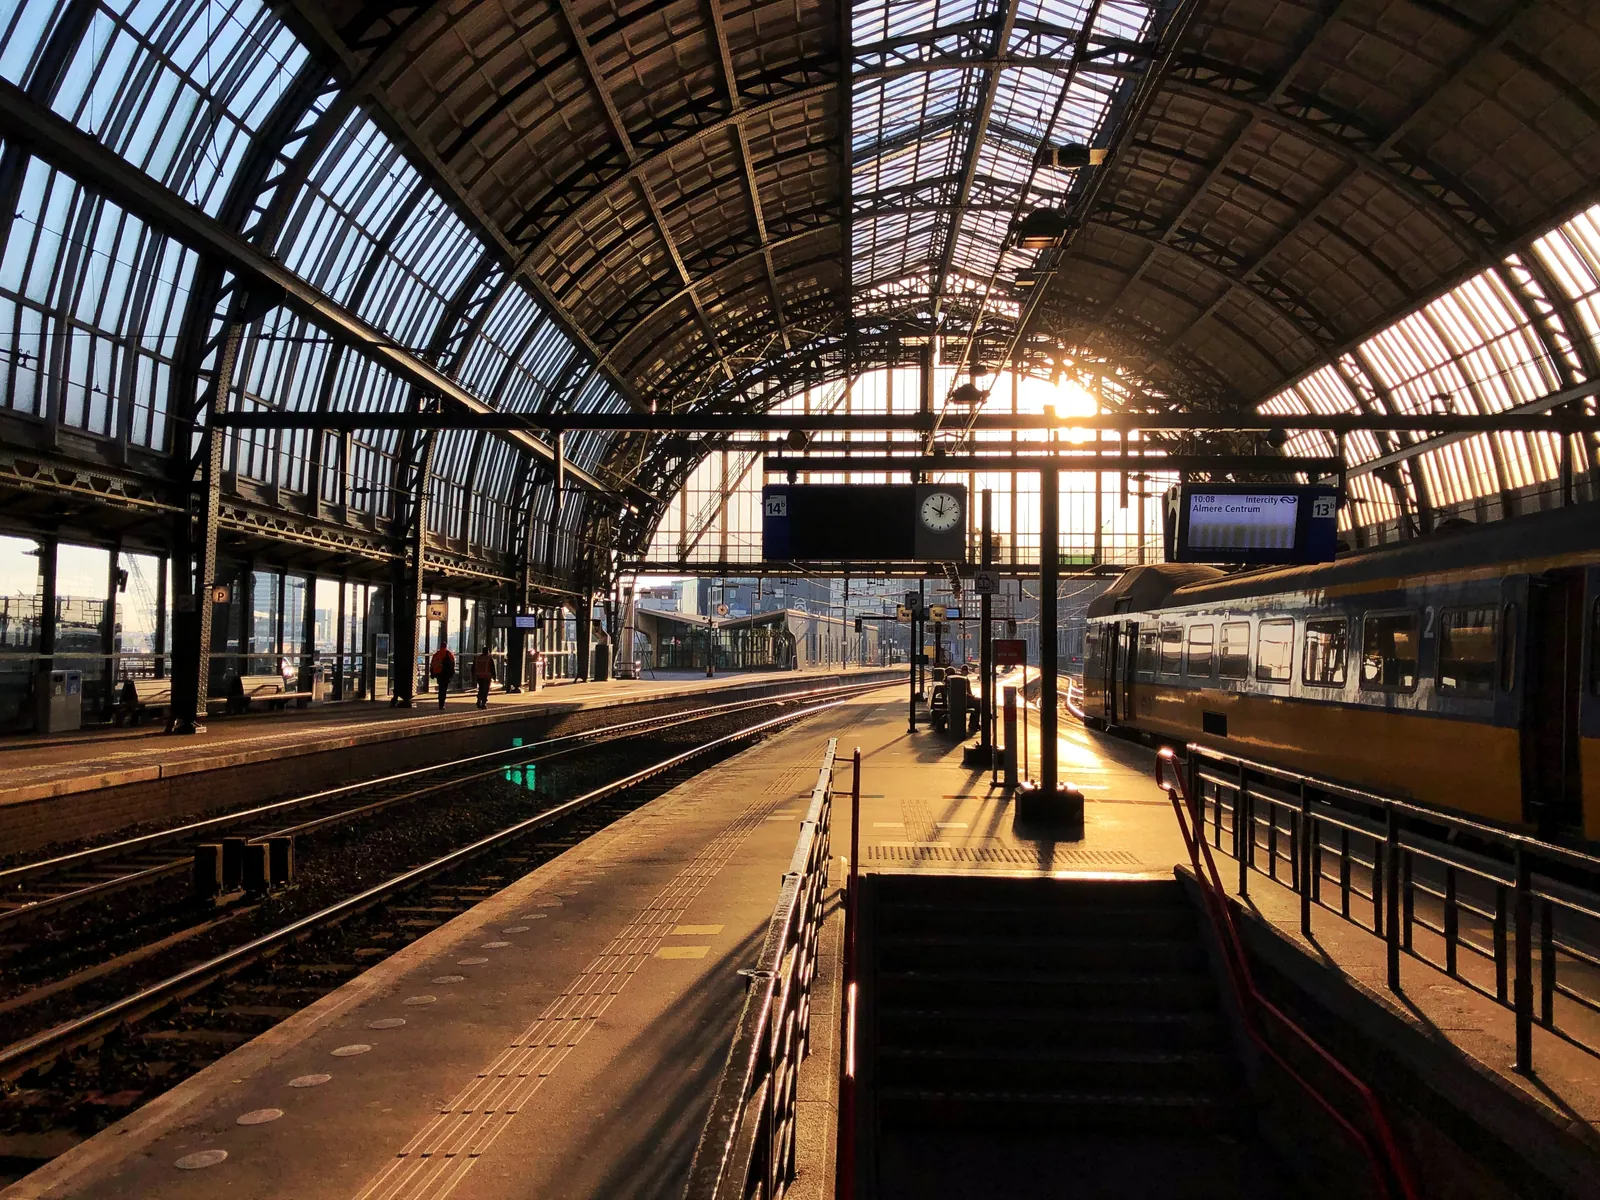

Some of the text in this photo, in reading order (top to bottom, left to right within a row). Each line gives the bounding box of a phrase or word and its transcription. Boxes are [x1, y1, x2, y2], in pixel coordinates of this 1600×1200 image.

[1194, 495, 1279, 505] 10:08 Intercity
[1192, 504, 1261, 513] Almere Centrum
[217, 592, 225, 601] P
[910, 598, 918, 609] P
[1423, 605, 1435, 639] 2
